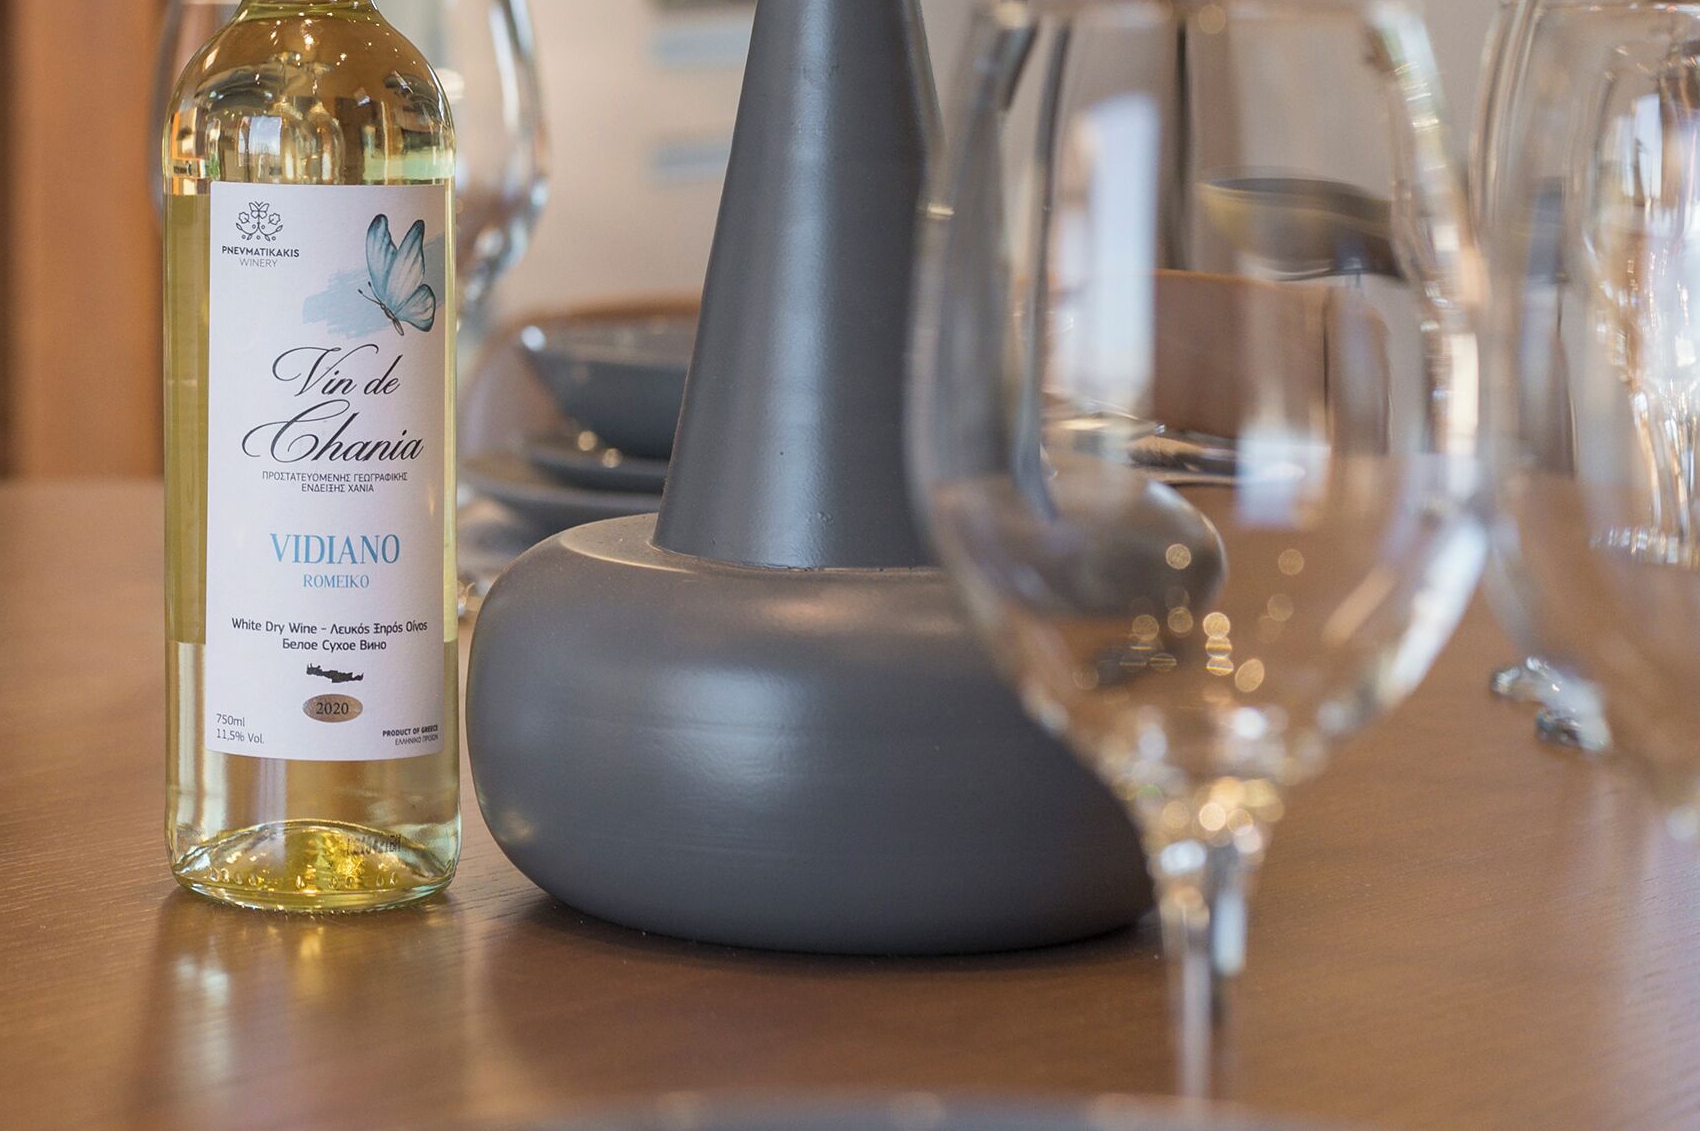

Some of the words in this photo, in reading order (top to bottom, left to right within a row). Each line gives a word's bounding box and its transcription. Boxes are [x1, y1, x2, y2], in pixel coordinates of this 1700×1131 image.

[222, 246, 299, 258] PNEVMATIKAKIS
[240, 258, 277, 268] WINERY
[272, 344, 379, 396] Vin
[364, 355, 403, 395] de
[242, 399, 424, 463] Chania
[262, 471, 351, 482] ΠΡΟΣΤΑΤΕΥΟΜΕΝΗΣ
[353, 471, 408, 482] ΓΕΩΓΡΑΦΙΚΗΣ
[301, 483, 345, 493] ΕΝΔΕΙΞΗΣ
[348, 483, 374, 493] ΧΑΝΙΑ
[270, 533, 400, 564] VIDIANO
[303, 574, 370, 588] ROMEIKO
[231, 618, 262, 631] White
[265, 621, 285, 635] Dry
[289, 622, 317, 634] Wine
[282, 638, 318, 650] Белое
[322, 640, 356, 653] Сухое
[360, 639, 387, 650] Вино
[316, 702, 349, 715] 2020
[216, 714, 245, 727] 750ml
[248, 732, 265, 744] Vol.
[382, 728, 411, 737] PRODUCT
[412, 727, 420, 735] OF
